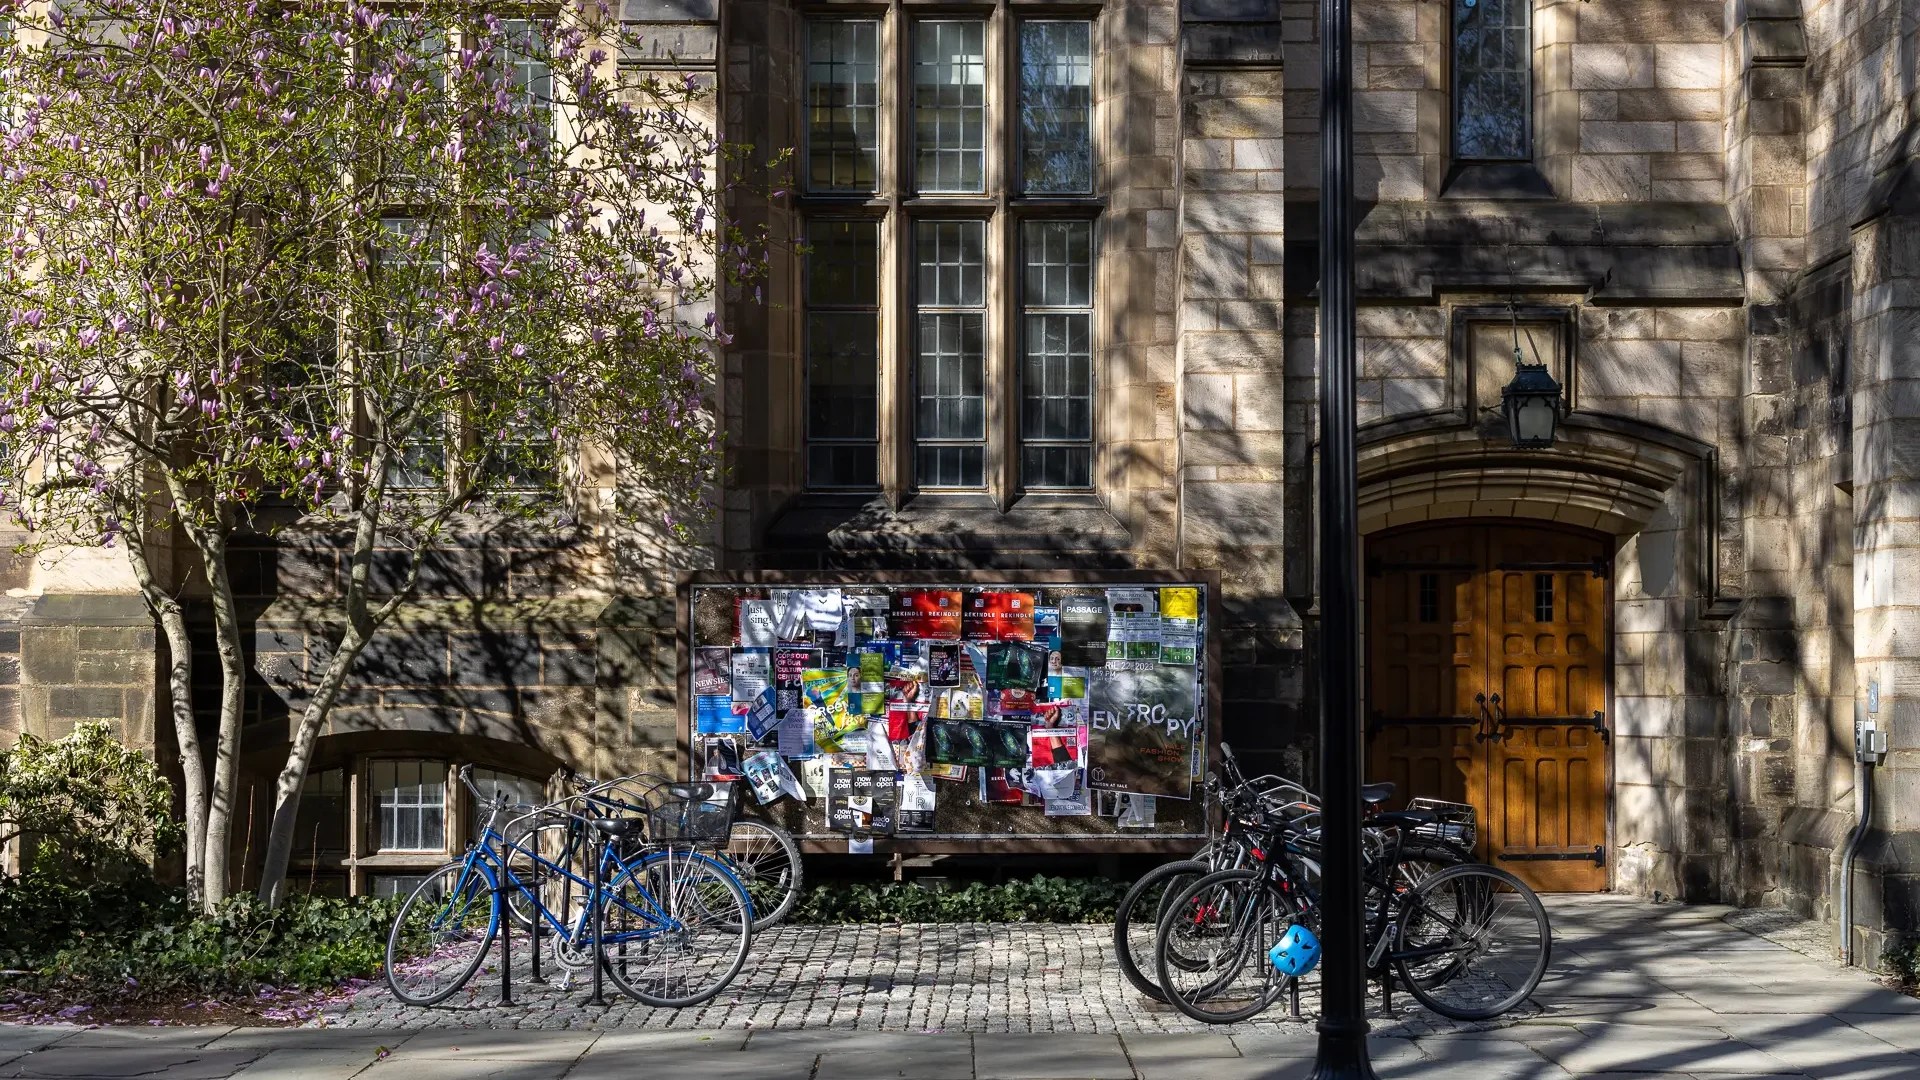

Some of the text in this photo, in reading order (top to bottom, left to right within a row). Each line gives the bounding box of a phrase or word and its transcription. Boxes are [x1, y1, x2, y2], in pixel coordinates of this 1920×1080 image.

[750, 614, 772, 626] sing!
[1135, 662, 1154, 670] 2023
[696, 676, 730, 688] NEWSIES
